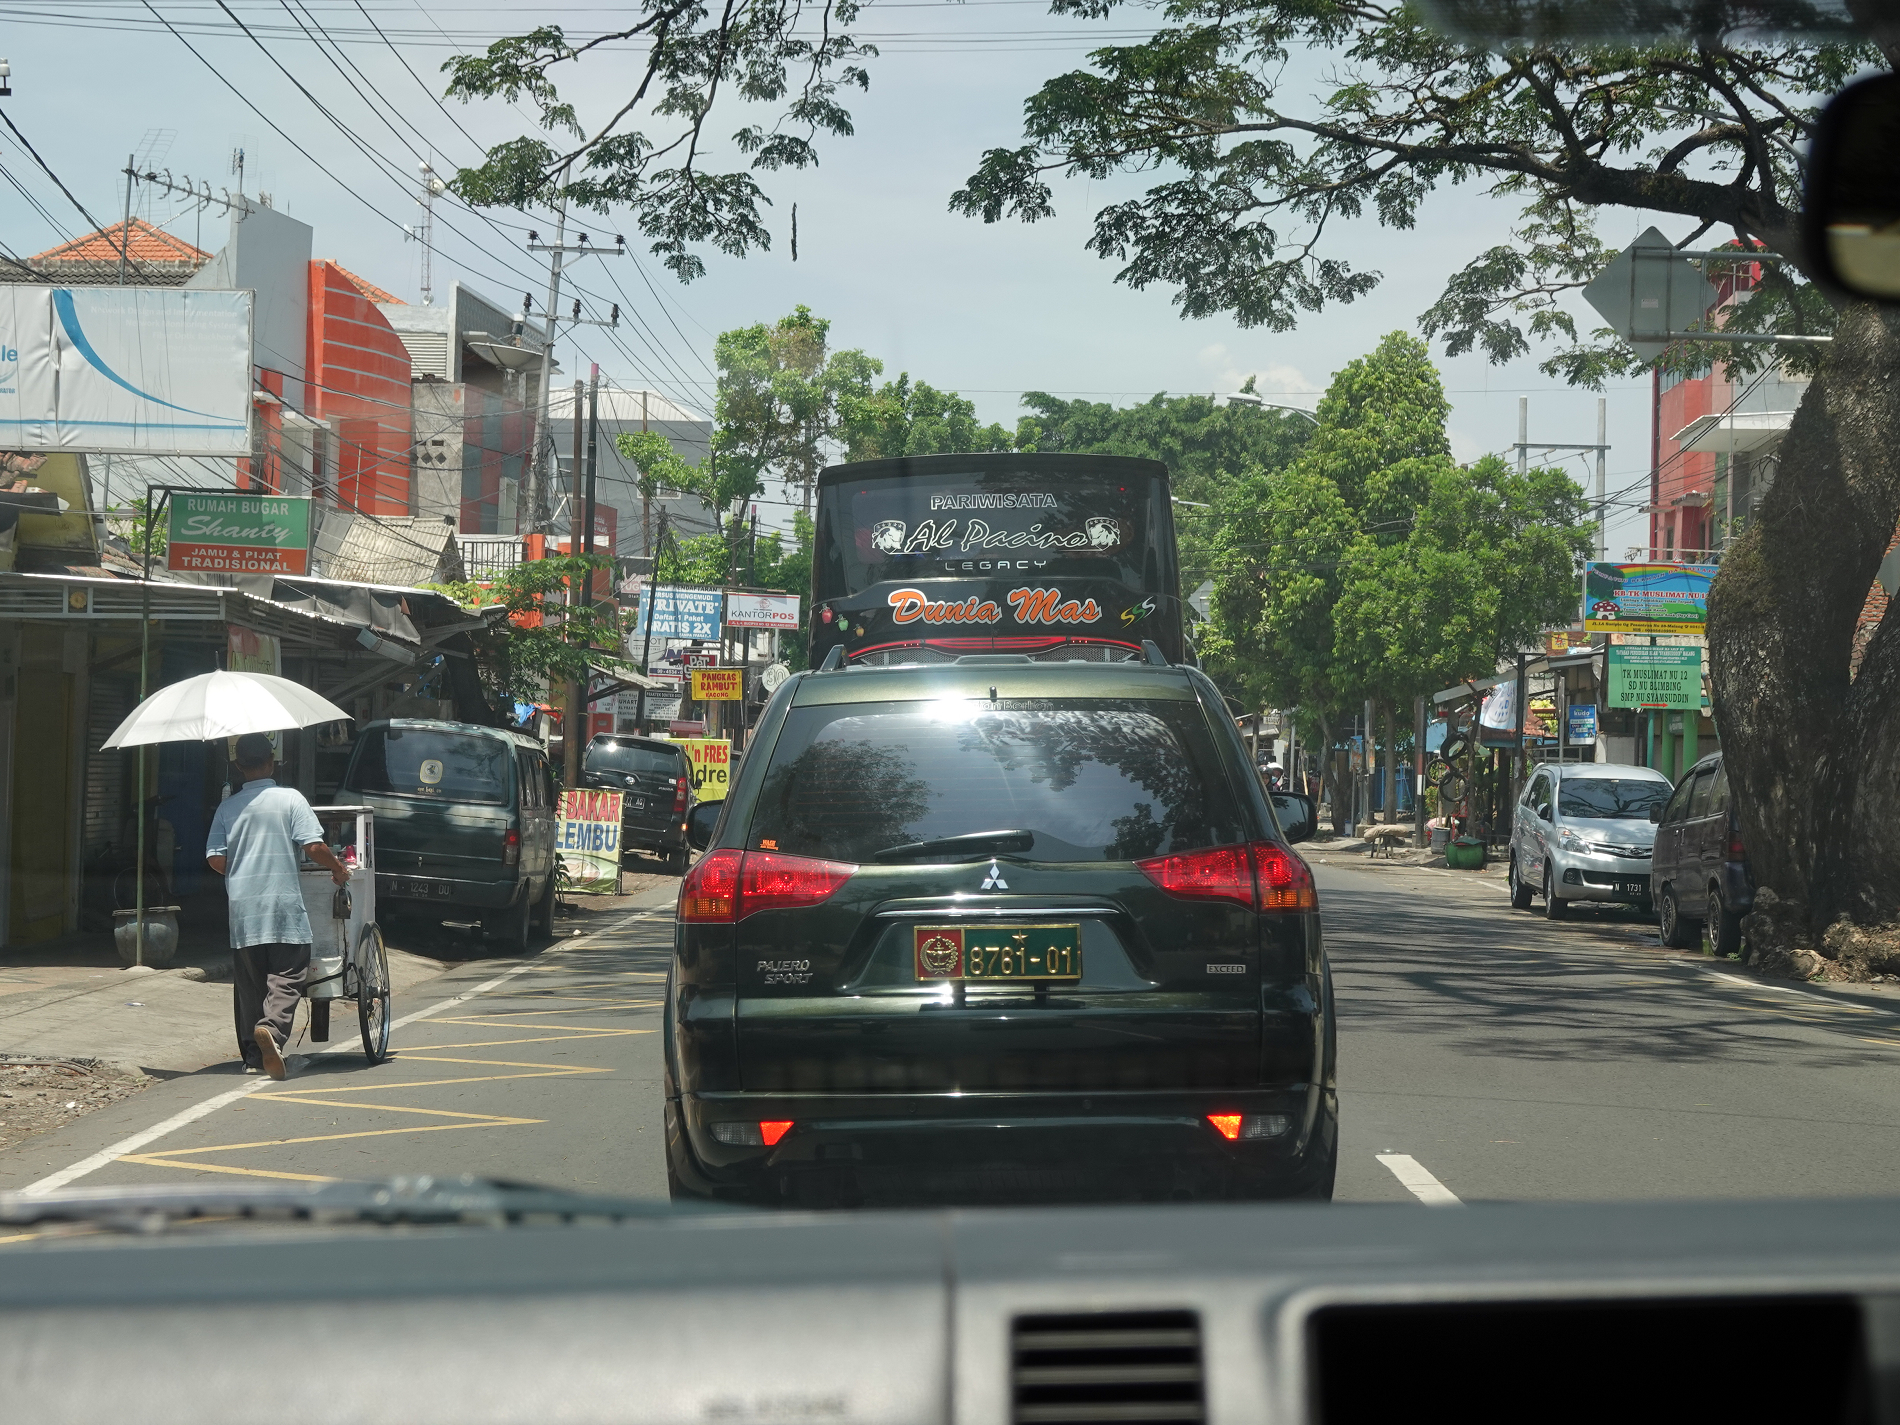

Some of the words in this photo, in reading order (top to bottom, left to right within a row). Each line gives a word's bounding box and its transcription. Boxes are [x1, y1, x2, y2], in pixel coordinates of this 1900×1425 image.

[188, 498, 236, 512] RUMAH
[242, 502, 288, 515] BUGAR
[930, 494, 1058, 510] PARIWISATA
[181, 516, 293, 544] Shanty
[904, 518, 958, 552] Al
[960, 518, 1089, 552] Pacino
[192, 548, 227, 557] JAMU
[246, 551, 282, 560] PIJAT
[182, 557, 292, 572] TRADISIONAL
[945, 560, 1047, 570] LEGACY
[676, 592, 713, 601] MENGEMUDI
[1642, 590, 1686, 598] MUSLIMAT
[888, 588, 1002, 624] Dunia
[1007, 587, 1102, 624] Mas
[693, 622, 712, 634] 2X
[702, 673, 737, 682] PANGKAS
[1622, 669, 1631, 678] TK
[1633, 670, 1667, 680] MUSLIMAT
[1669, 670, 1678, 680] NU
[1680, 671, 1688, 680] 12
[700, 682, 737, 691] RAMBUT
[1628, 681, 1637, 690] SD
[1639, 682, 1648, 690] NU
[1649, 682, 1682, 691] BLIMBING
[1621, 693, 1634, 702] SMP
[1636, 693, 1645, 702] NU
[1647, 693, 1689, 703] SYAMSUDDIN
[567, 791, 620, 822] BAKAR
[392, 881, 398, 890] N
[410, 882, 429, 893] 1243
[1627, 884, 1642, 892] 1731
[756, 959, 811, 972] PAJERO
[970, 946, 1074, 976] 8761-01
[1206, 964, 1246, 974] EXCEED
[764, 972, 813, 984] SPORT
